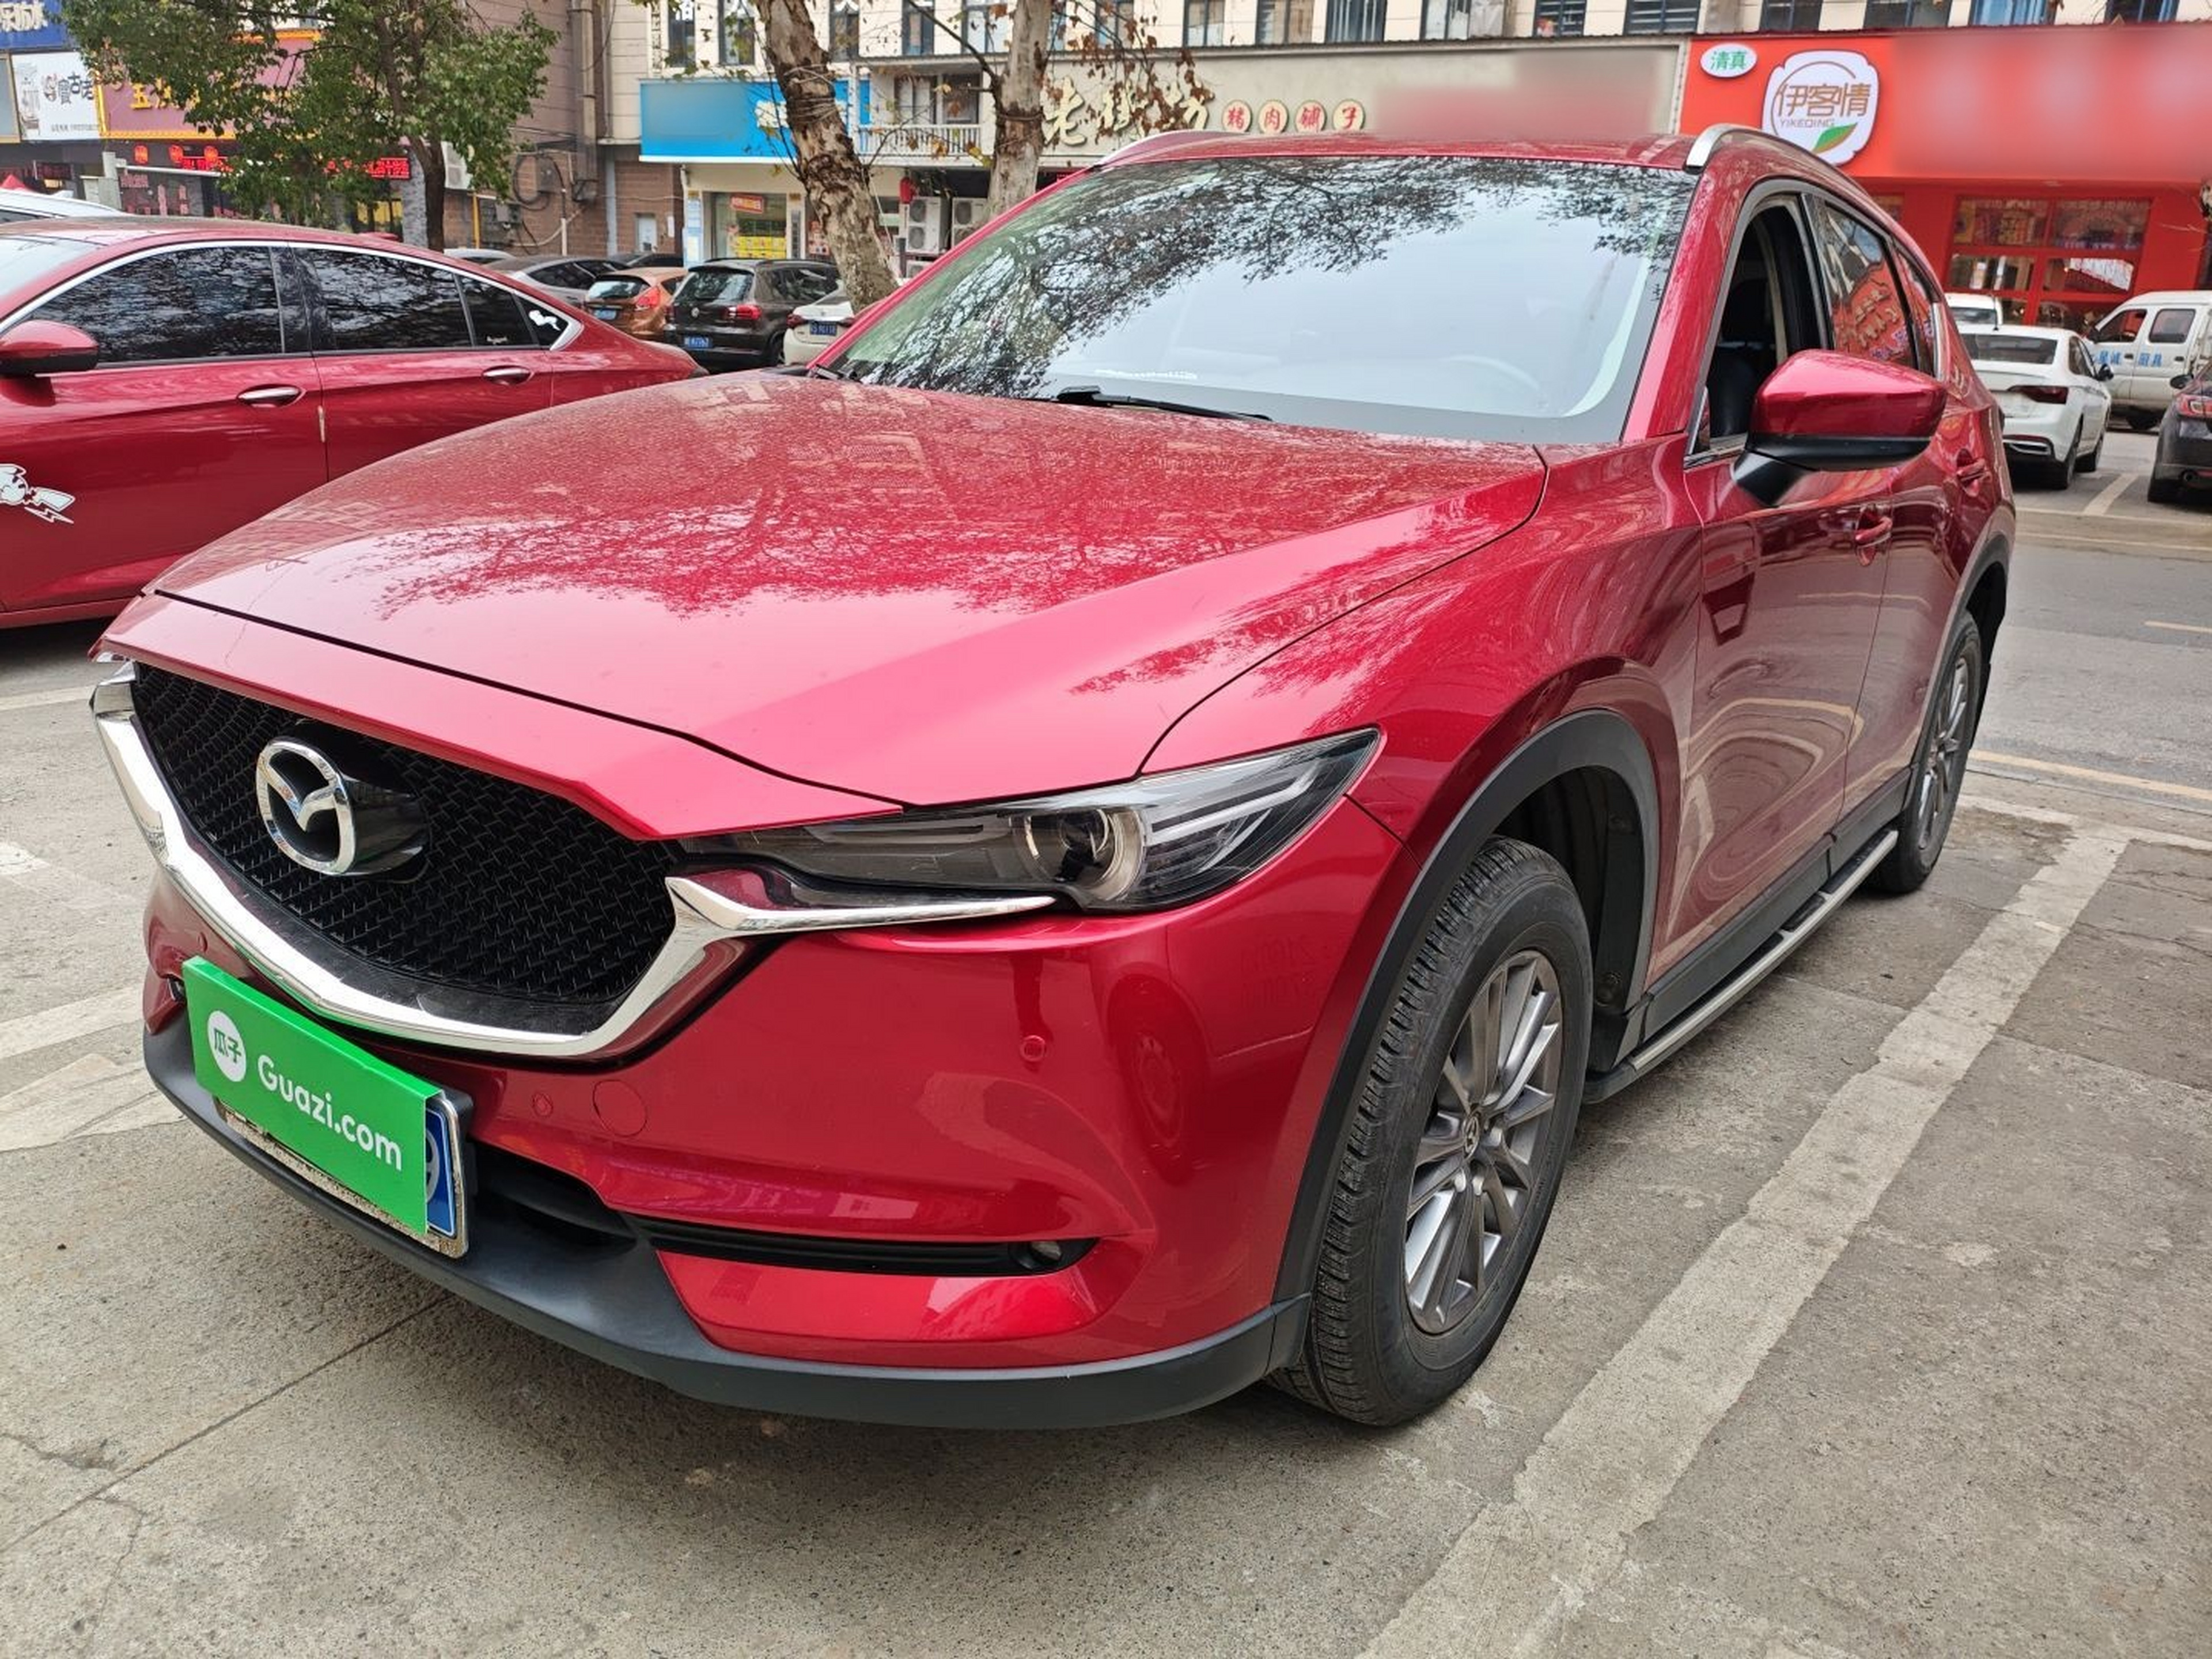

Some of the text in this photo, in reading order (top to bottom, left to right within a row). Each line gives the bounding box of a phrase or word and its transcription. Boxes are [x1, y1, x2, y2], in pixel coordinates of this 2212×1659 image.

[1711, 51, 1747, 70] 清真
[1778, 83, 1872, 118] 伊客情
[214, 1028, 242, 1064] 瓜子
[257, 1054, 402, 1172] Guazi.com
